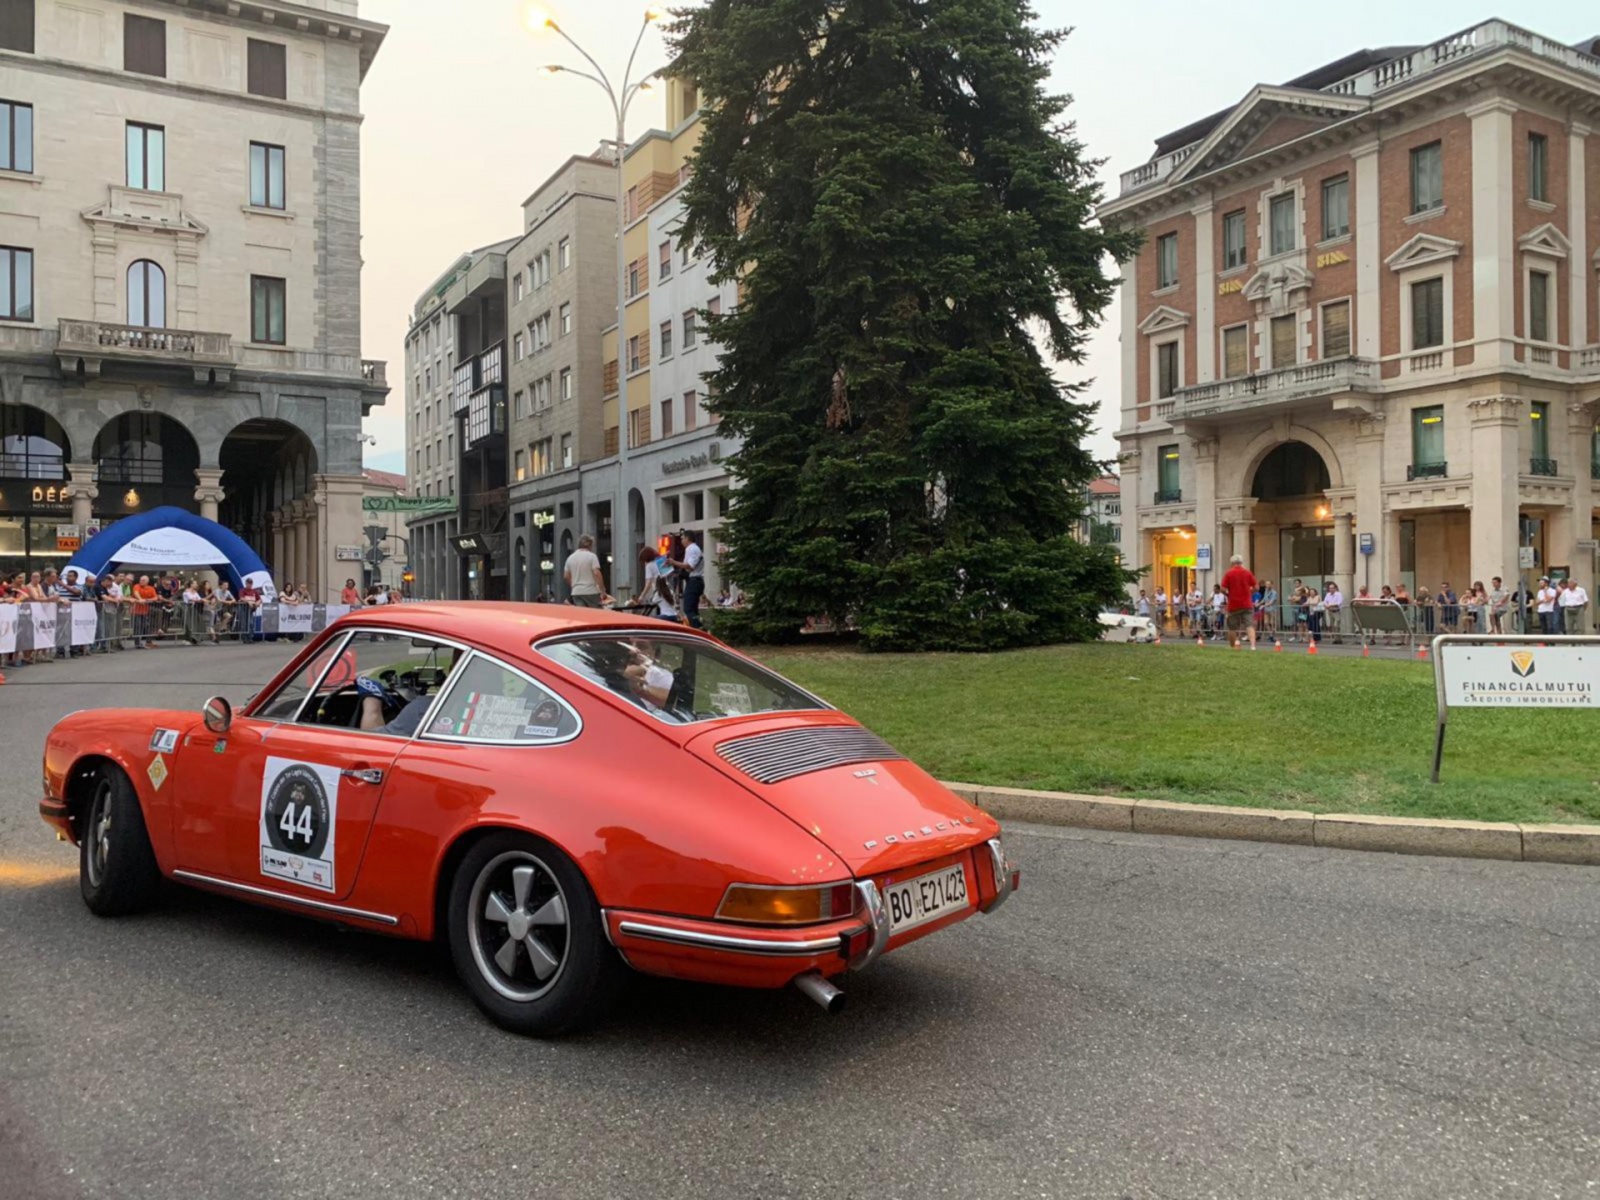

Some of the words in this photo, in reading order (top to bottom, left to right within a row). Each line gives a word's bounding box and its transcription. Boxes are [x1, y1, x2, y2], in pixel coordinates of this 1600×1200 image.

[1462, 681, 1592, 692] FINANCIALMUTUI
[1464, 696, 1512, 704] CREDITO
[1517, 696, 1593, 704] IMMOBILIARE
[525, 727, 557, 736] VERIFICATO
[280, 802, 313, 844] 44
[864, 817, 973, 850] PORSCHE
[889, 888, 913, 924] BO
[920, 869, 966, 913] E21423
